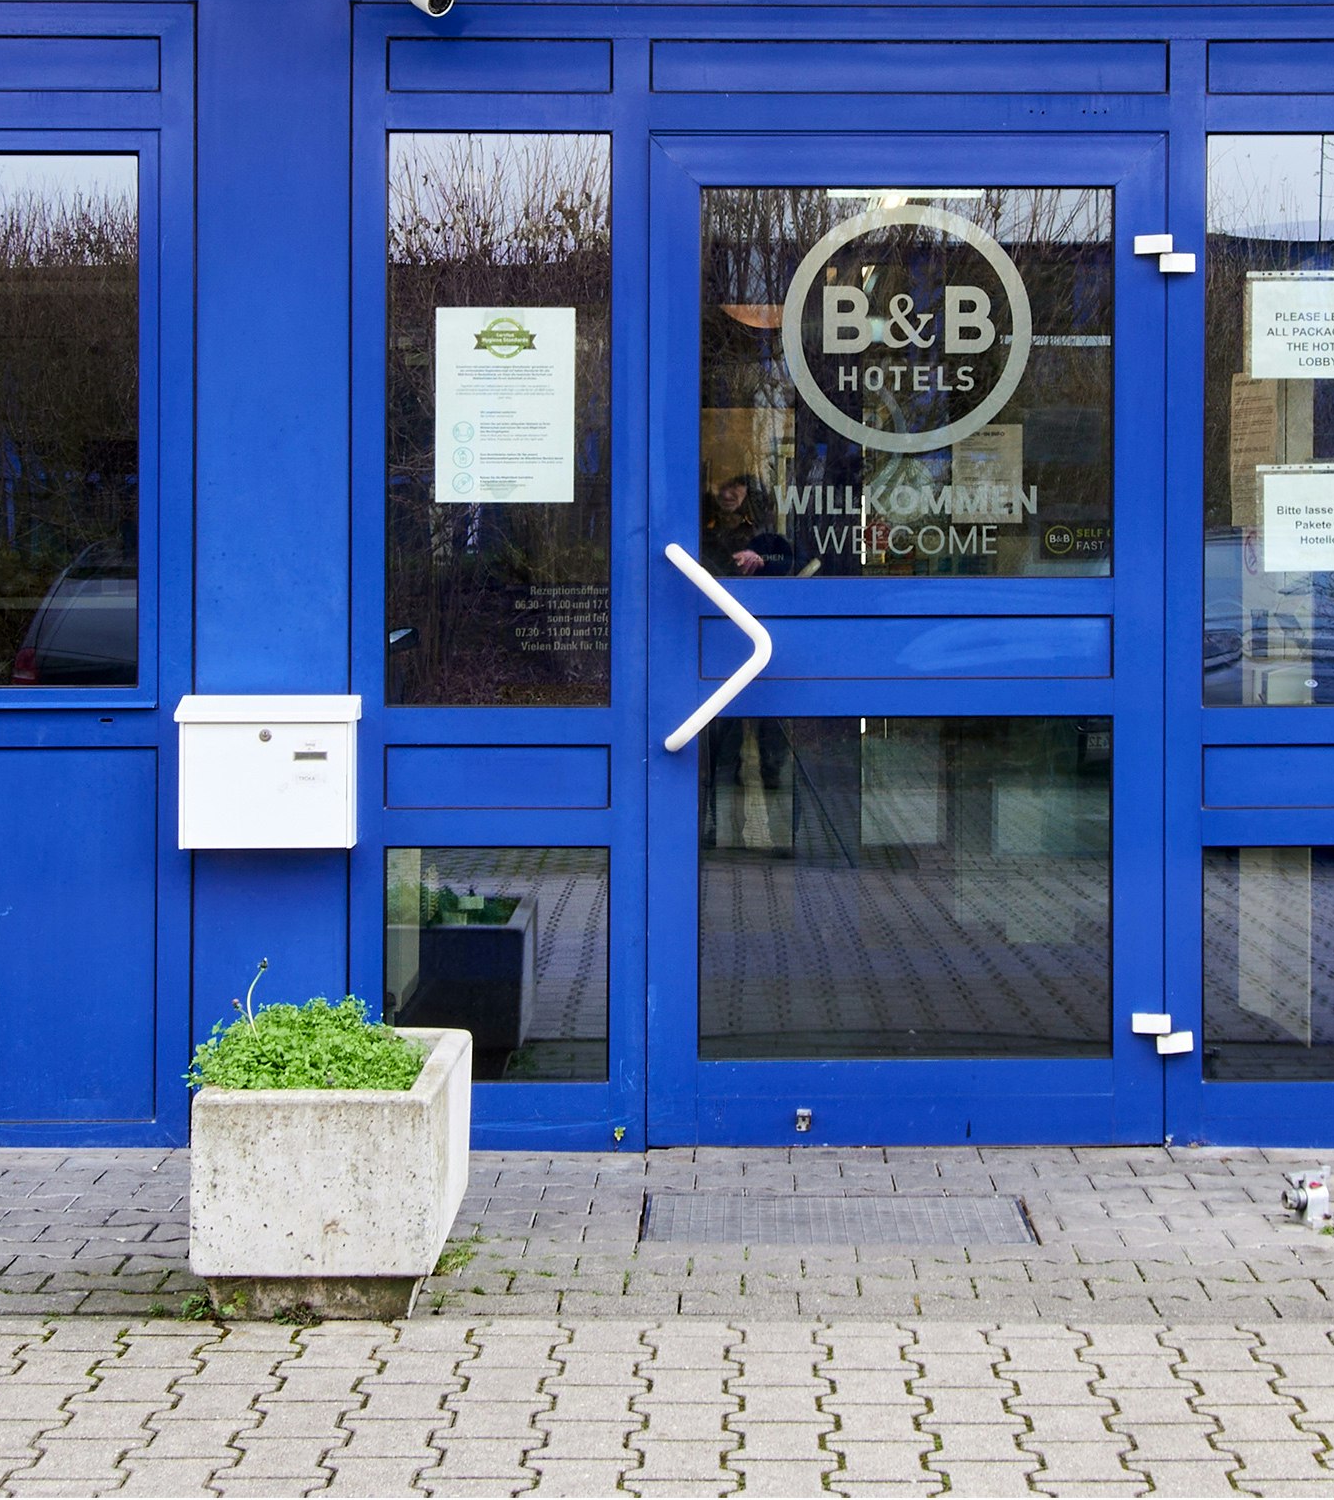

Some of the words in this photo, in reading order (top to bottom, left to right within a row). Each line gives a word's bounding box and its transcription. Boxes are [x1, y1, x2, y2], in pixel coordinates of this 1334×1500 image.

[822, 285, 996, 354] B&B
[1275, 312, 1320, 322] PLEASE
[1267, 327, 1289, 337] ALL
[1287, 342, 1309, 352] THE
[838, 365, 975, 392] HOTELS
[774, 485, 1038, 515] WILLKOMMEN
[1276, 505, 1302, 515] Bitte
[1295, 520, 1332, 530] Pakete
[1076, 528, 1103, 538] SELF
[813, 525, 998, 555] WELCOME
[1076, 540, 1105, 550] FAST
[547, 600, 571, 610] 11.00
[572, 600, 591, 609] und
[547, 627, 571, 637] 11.00
[572, 627, 591, 637] und
[521, 641, 551, 651] Vielen
[553, 641, 578, 651] Dank
[580, 640, 593, 650] für
